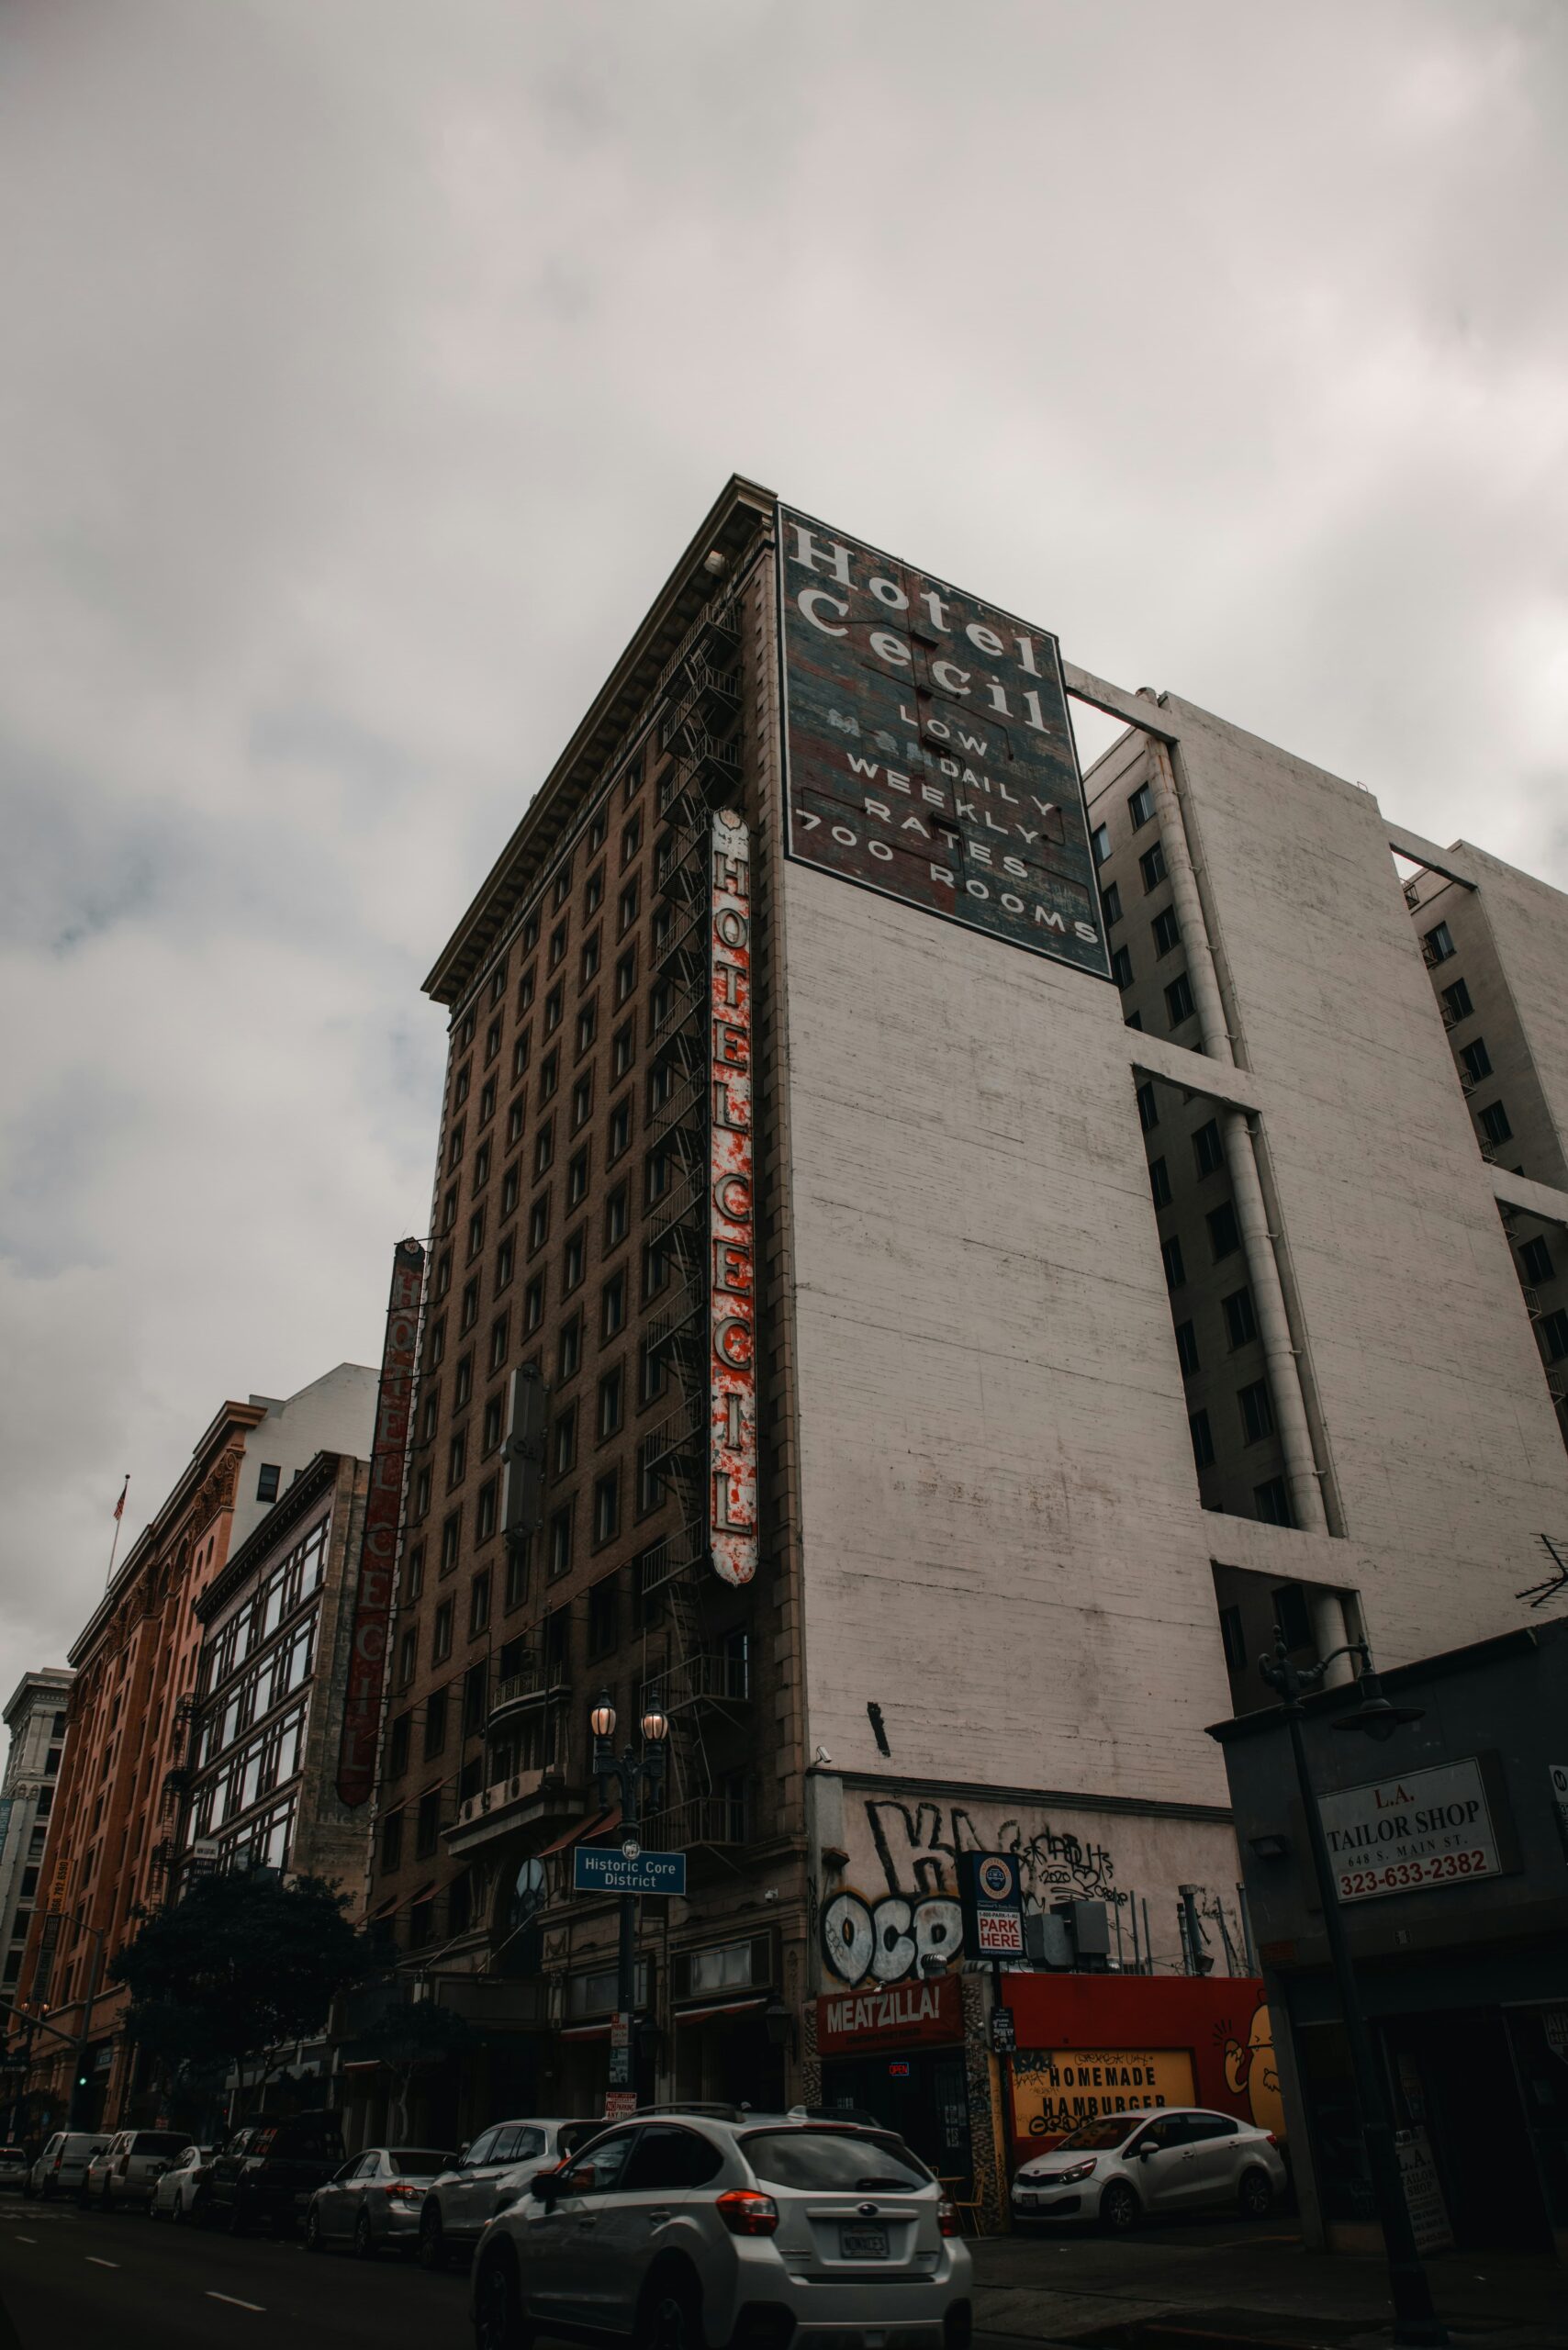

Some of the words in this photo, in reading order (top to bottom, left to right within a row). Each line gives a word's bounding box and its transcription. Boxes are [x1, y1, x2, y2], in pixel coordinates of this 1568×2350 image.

[789, 522, 1042, 678] Hotel
[798, 588, 1050, 734] Cecil
[900, 705, 988, 756] LOW
[846, 753, 1039, 844] WEEKLY
[940, 757, 1053, 815] DAILY
[864, 797, 1028, 878] RATES
[796, 809, 893, 860] 700
[930, 863, 1099, 944] ROOMS
[713, 851, 749, 1135] HOTEL
[712, 1172, 754, 1538] CECIL
[375, 1272, 420, 1493] HOTEL
[343, 1521, 394, 1772] CECIL
[1374, 1784, 1415, 1809] L.A.
[1327, 1815, 1412, 1852] TAILOR
[1415, 1800, 1479, 1833] SHOP
[585, 1857, 639, 1873] Historic
[645, 1861, 677, 1874] Core
[1341, 1850, 1487, 1896] 323-633-2382
[1348, 1852, 1370, 1867] 648
[1376, 1850, 1390, 1860] S.
[1396, 1839, 1436, 1857] MAIN
[1444, 1834, 1469, 1847] ST.
[604, 1873, 657, 1887] District
[980, 1919, 1018, 1933] PARK
[980, 1933, 1021, 1948] HERE
[827, 1985, 941, 2034] MEATZILLA!
[889, 2065, 909, 2075] OPEN
[1049, 2066, 1156, 2087] HOMEMADE
[607, 2102, 616, 2111] NO
[616, 2103, 634, 2111] PARKING
[607, 2111, 619, 2120] ANY
[1395, 2149, 1431, 2172] L.A.
[1407, 2181, 1433, 2197] SHOP
